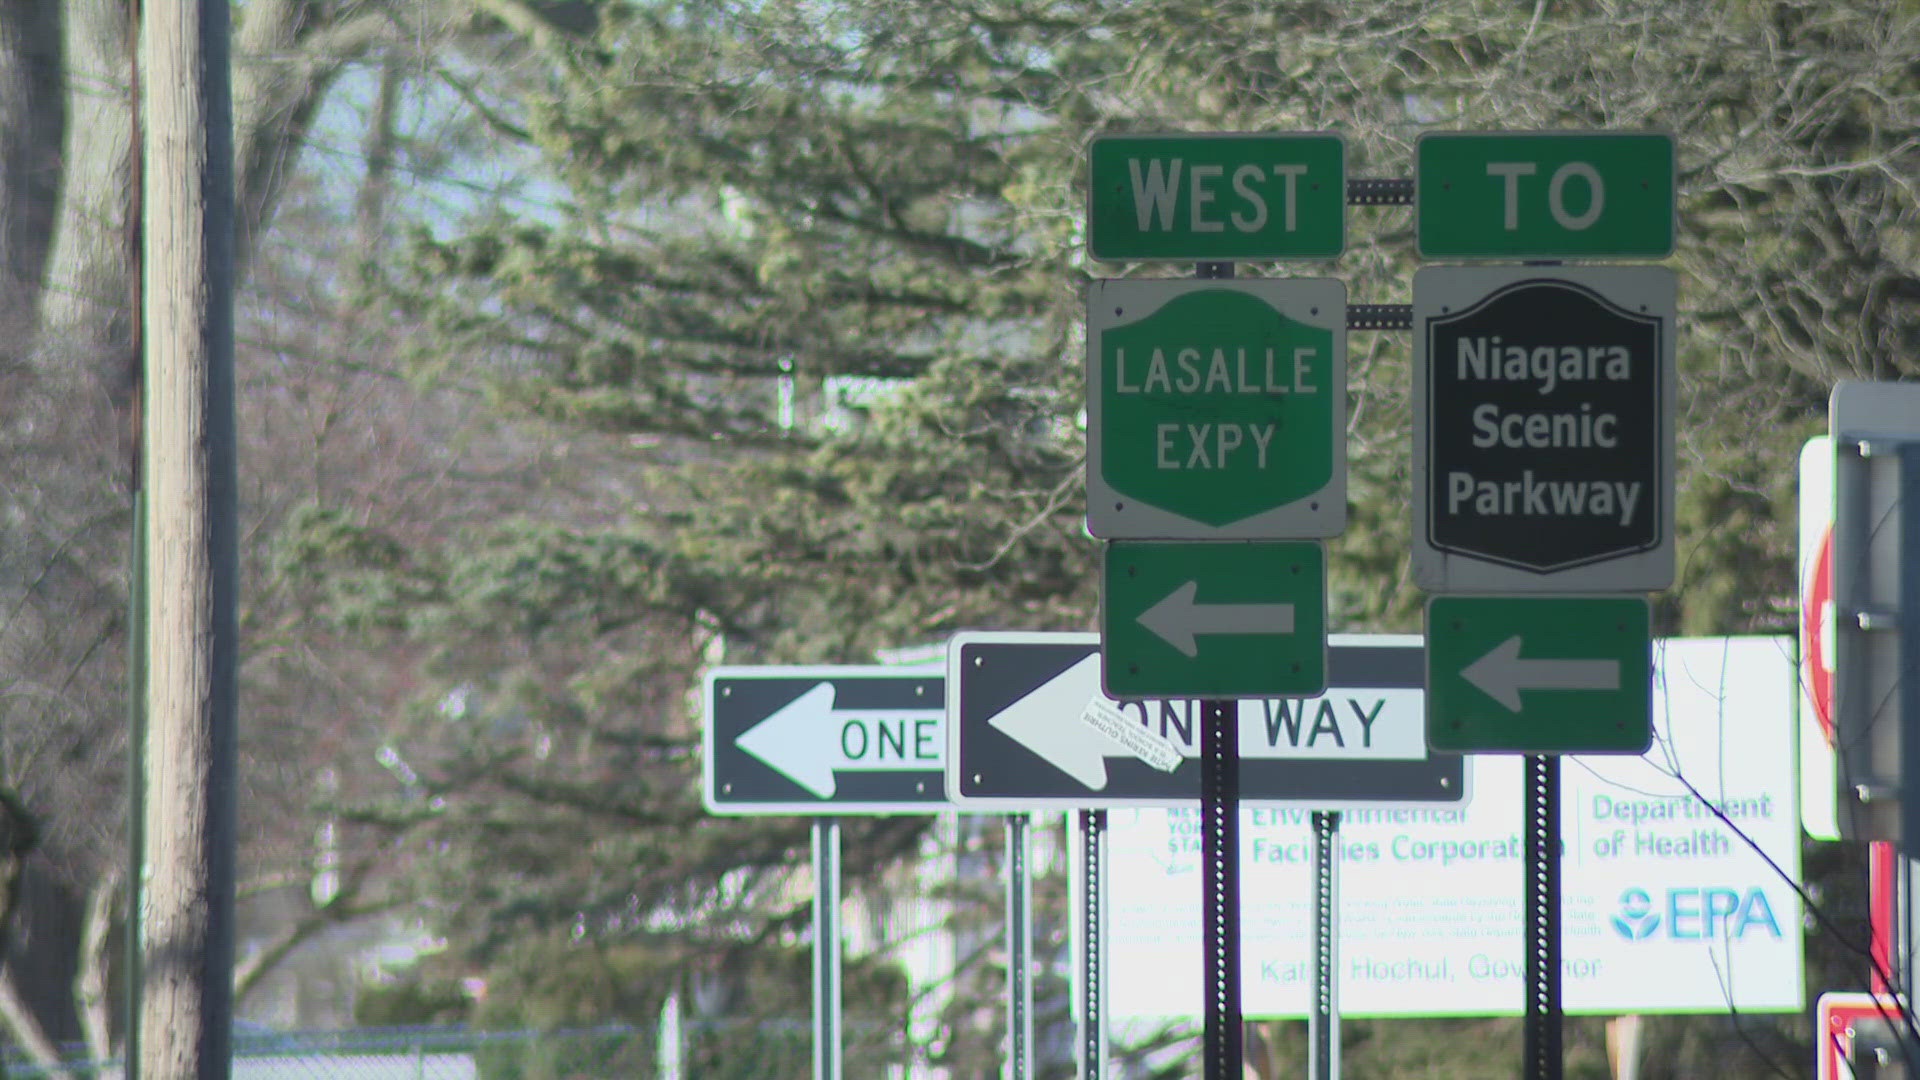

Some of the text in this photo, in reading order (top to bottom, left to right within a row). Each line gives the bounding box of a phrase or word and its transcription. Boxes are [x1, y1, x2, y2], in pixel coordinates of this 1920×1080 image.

[1129, 159, 1307, 232] WEST
[1487, 162, 1604, 230] TO
[1117, 348, 1316, 393] LASALLE
[1458, 337, 1629, 394] Niagara
[1158, 424, 1274, 468] EXPY
[1473, 404, 1616, 447] Scenic
[1449, 471, 1640, 525] Parkway
[842, 719, 939, 760] ONE
[1117, 699, 1193, 747] ON
[1262, 699, 1387, 748] WAY
[1593, 794, 1773, 825] Department
[1253, 836, 1380, 863] Faciies
[1593, 829, 1730, 858] of Health
[1667, 887, 1782, 939] EPA
[1351, 955, 1456, 984] Hochul,
